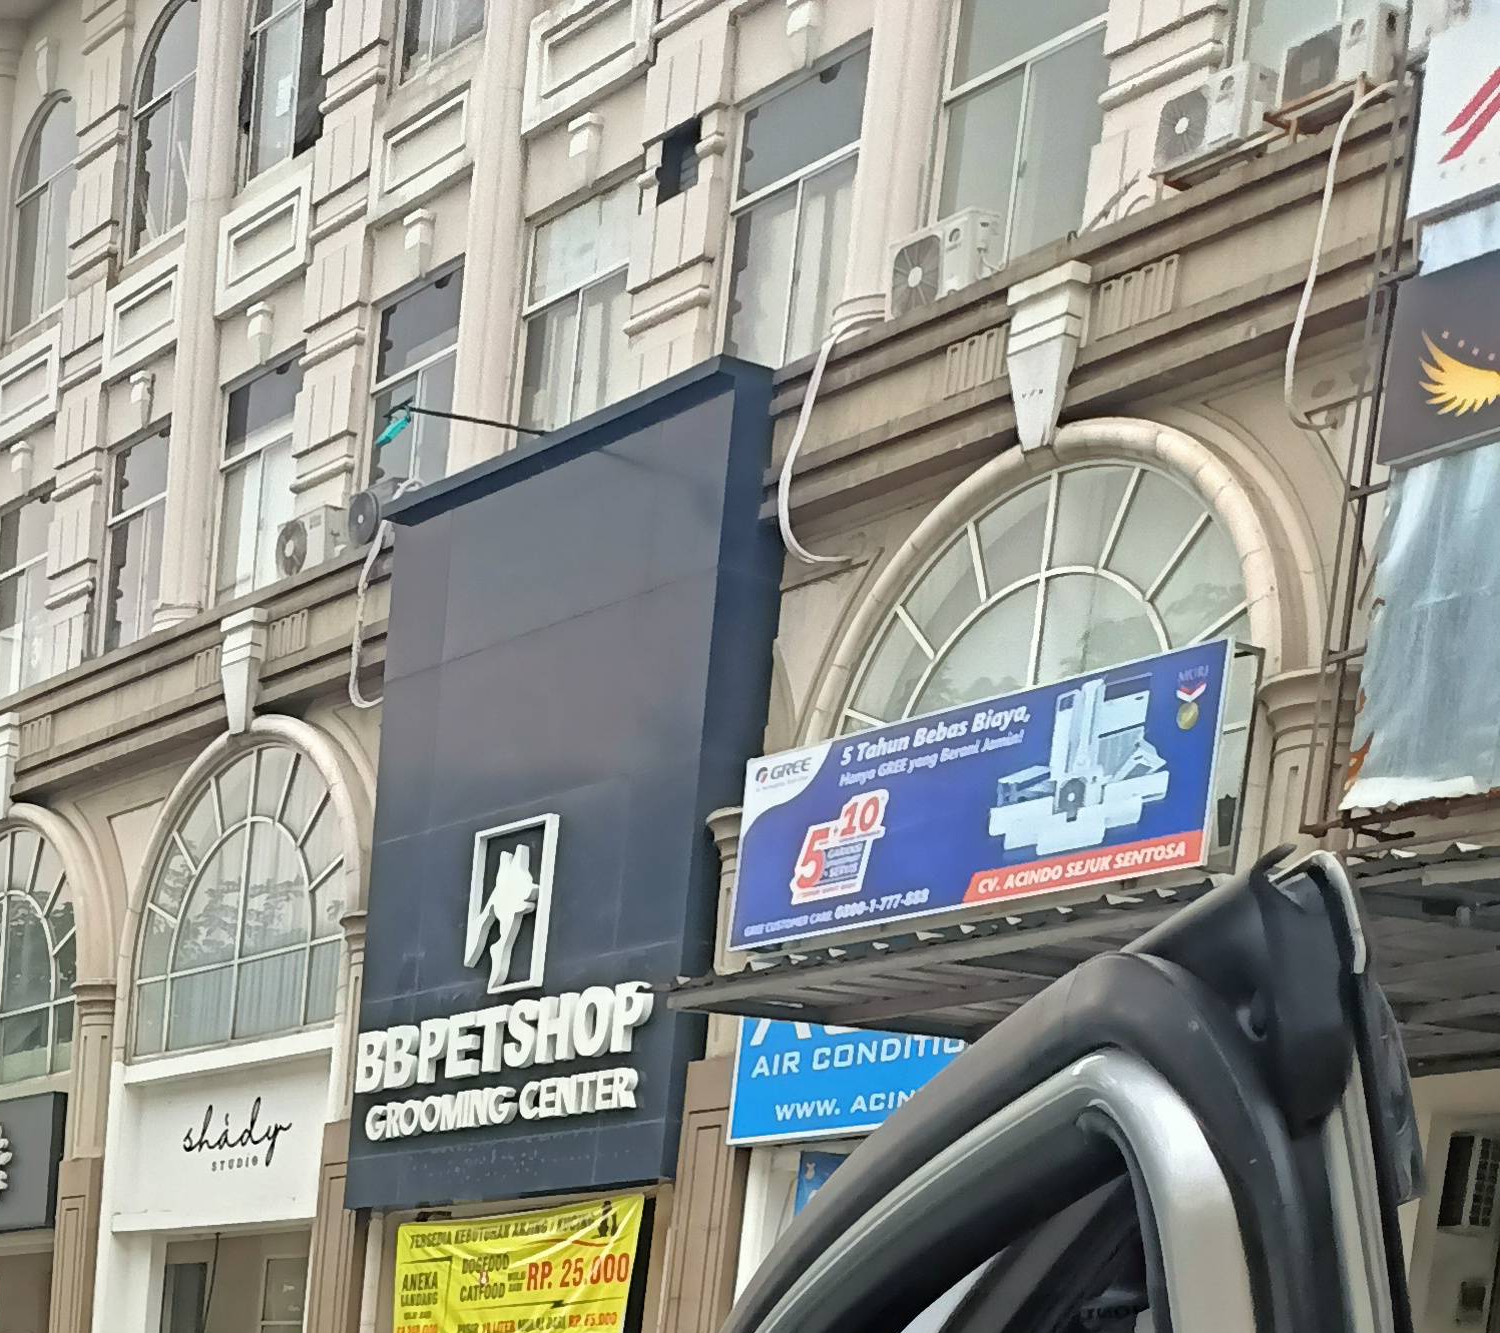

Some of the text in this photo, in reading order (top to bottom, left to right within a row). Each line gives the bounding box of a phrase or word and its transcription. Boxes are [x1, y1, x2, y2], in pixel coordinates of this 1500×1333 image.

[840, 704, 1031, 767] 5 Tahun Bebas Biaya,
[770, 757, 813, 780] GREE
[977, 841, 1186, 895] CV. ACINDO SEJUK SENTOSA
[354, 980, 654, 1094] BBPETSHOP
[750, 1051, 801, 1079] AIR
[364, 1066, 640, 1142] GROOMING CENTER
[211, 1155, 258, 1172] STUDIO
[559, 1252, 630, 1289] 25.000
[459, 1282, 506, 1303] CATFOOD
